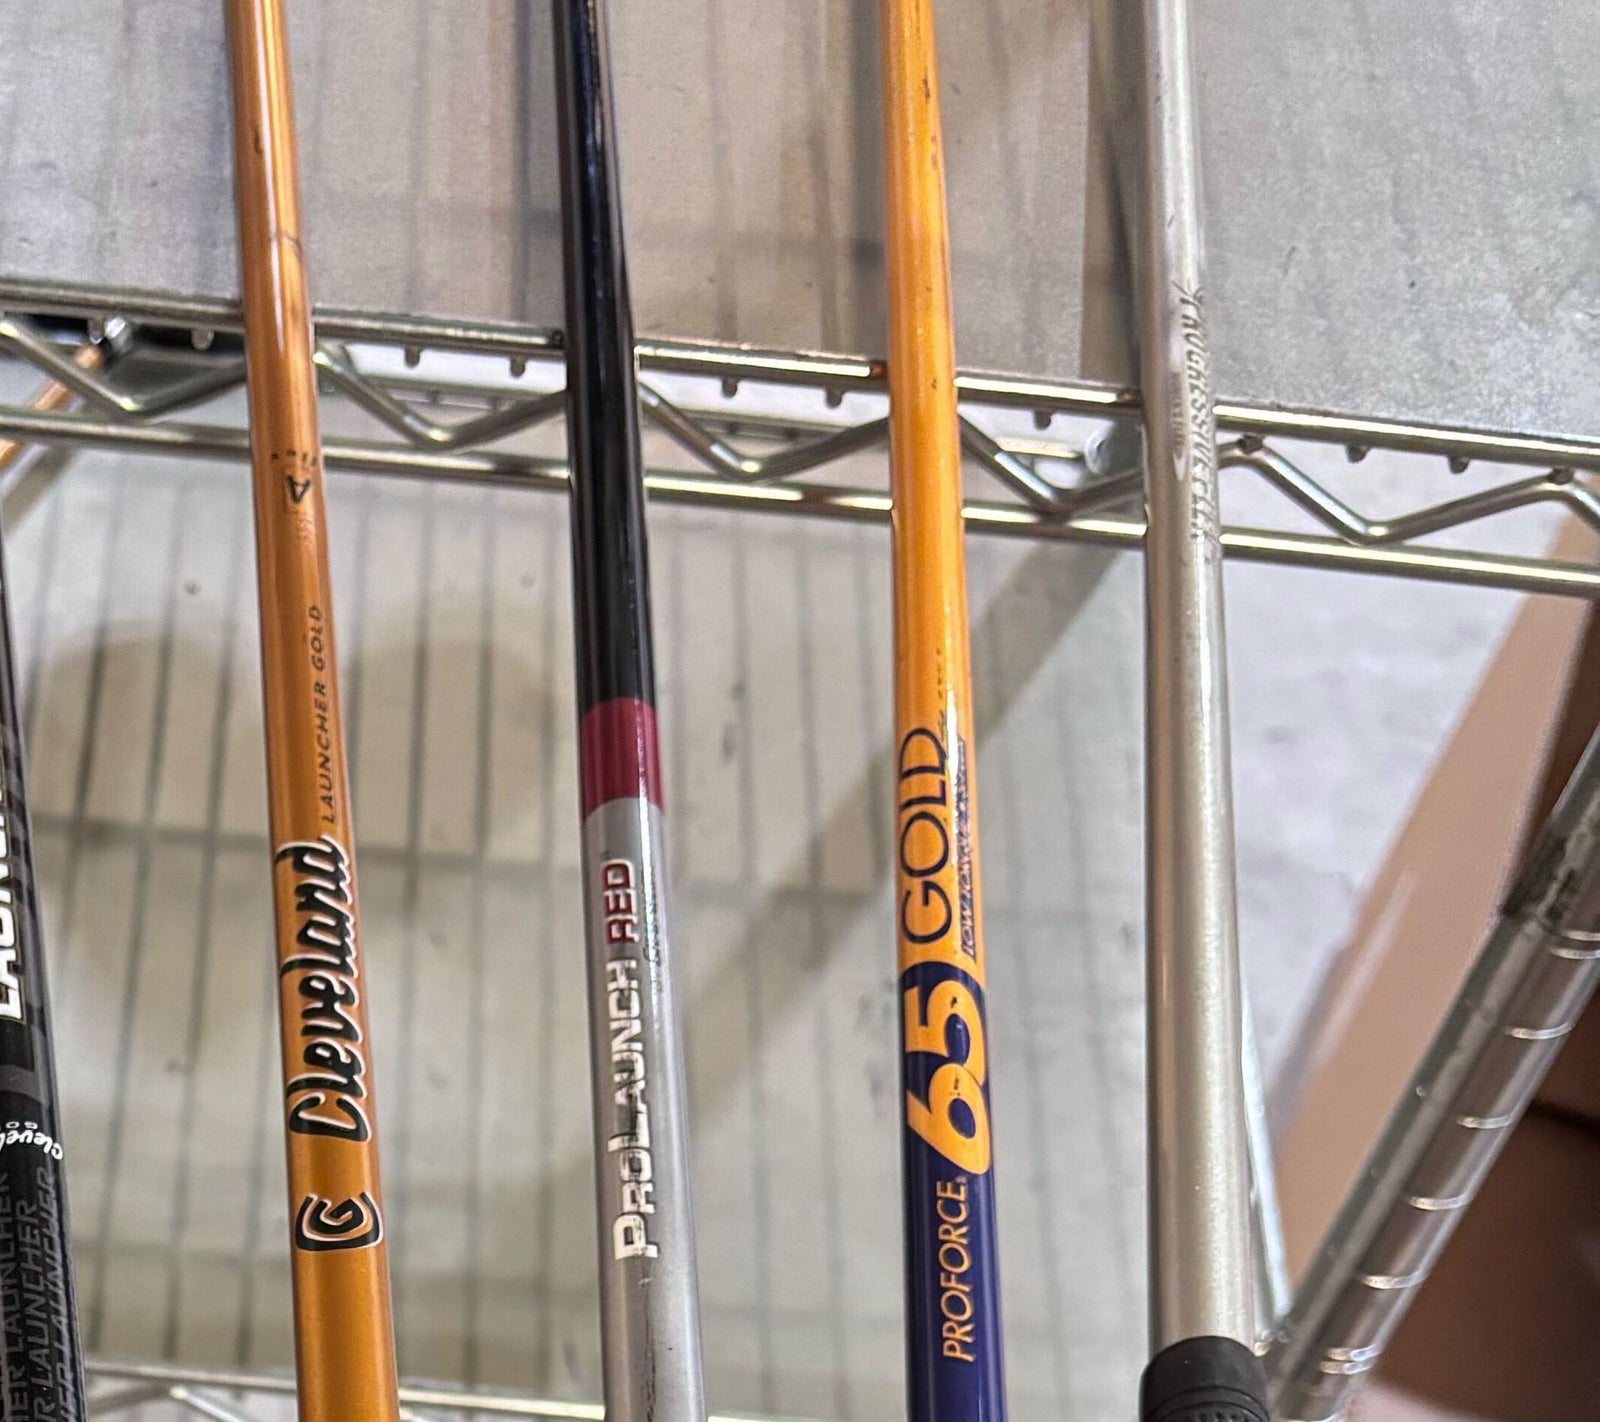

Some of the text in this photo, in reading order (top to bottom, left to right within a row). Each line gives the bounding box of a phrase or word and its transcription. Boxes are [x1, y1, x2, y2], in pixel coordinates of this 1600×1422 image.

[309, 605, 336, 824] LAUNCHER GOLD
[274, 832, 370, 1142] Cleveland
[601, 858, 637, 944] RED
[900, 727, 992, 1362] PROFORCE 65 GOLD
[14, 1201, 54, 1387] LAUNCHER
